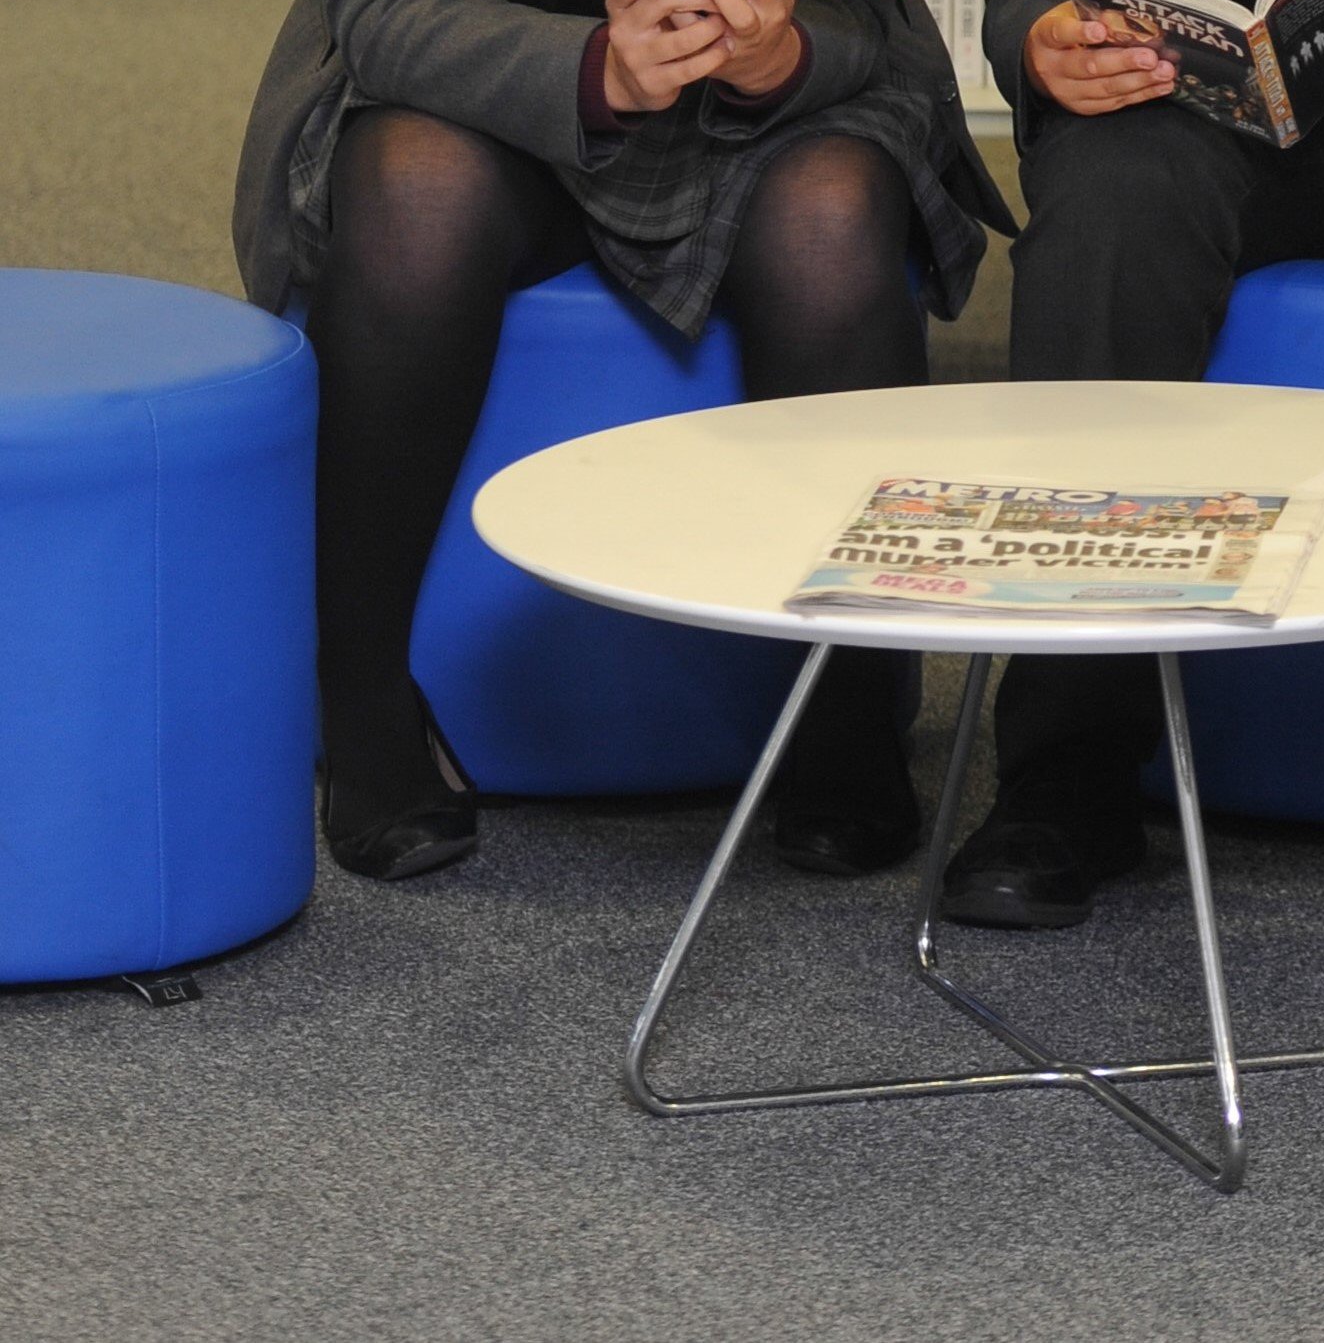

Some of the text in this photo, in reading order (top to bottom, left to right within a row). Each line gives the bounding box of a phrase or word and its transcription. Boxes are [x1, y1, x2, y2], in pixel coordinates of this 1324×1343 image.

[883, 479, 1110, 506] METRO
[837, 531, 921, 550] am
[933, 537, 964, 553] a
[829, 546, 1023, 568] murder
